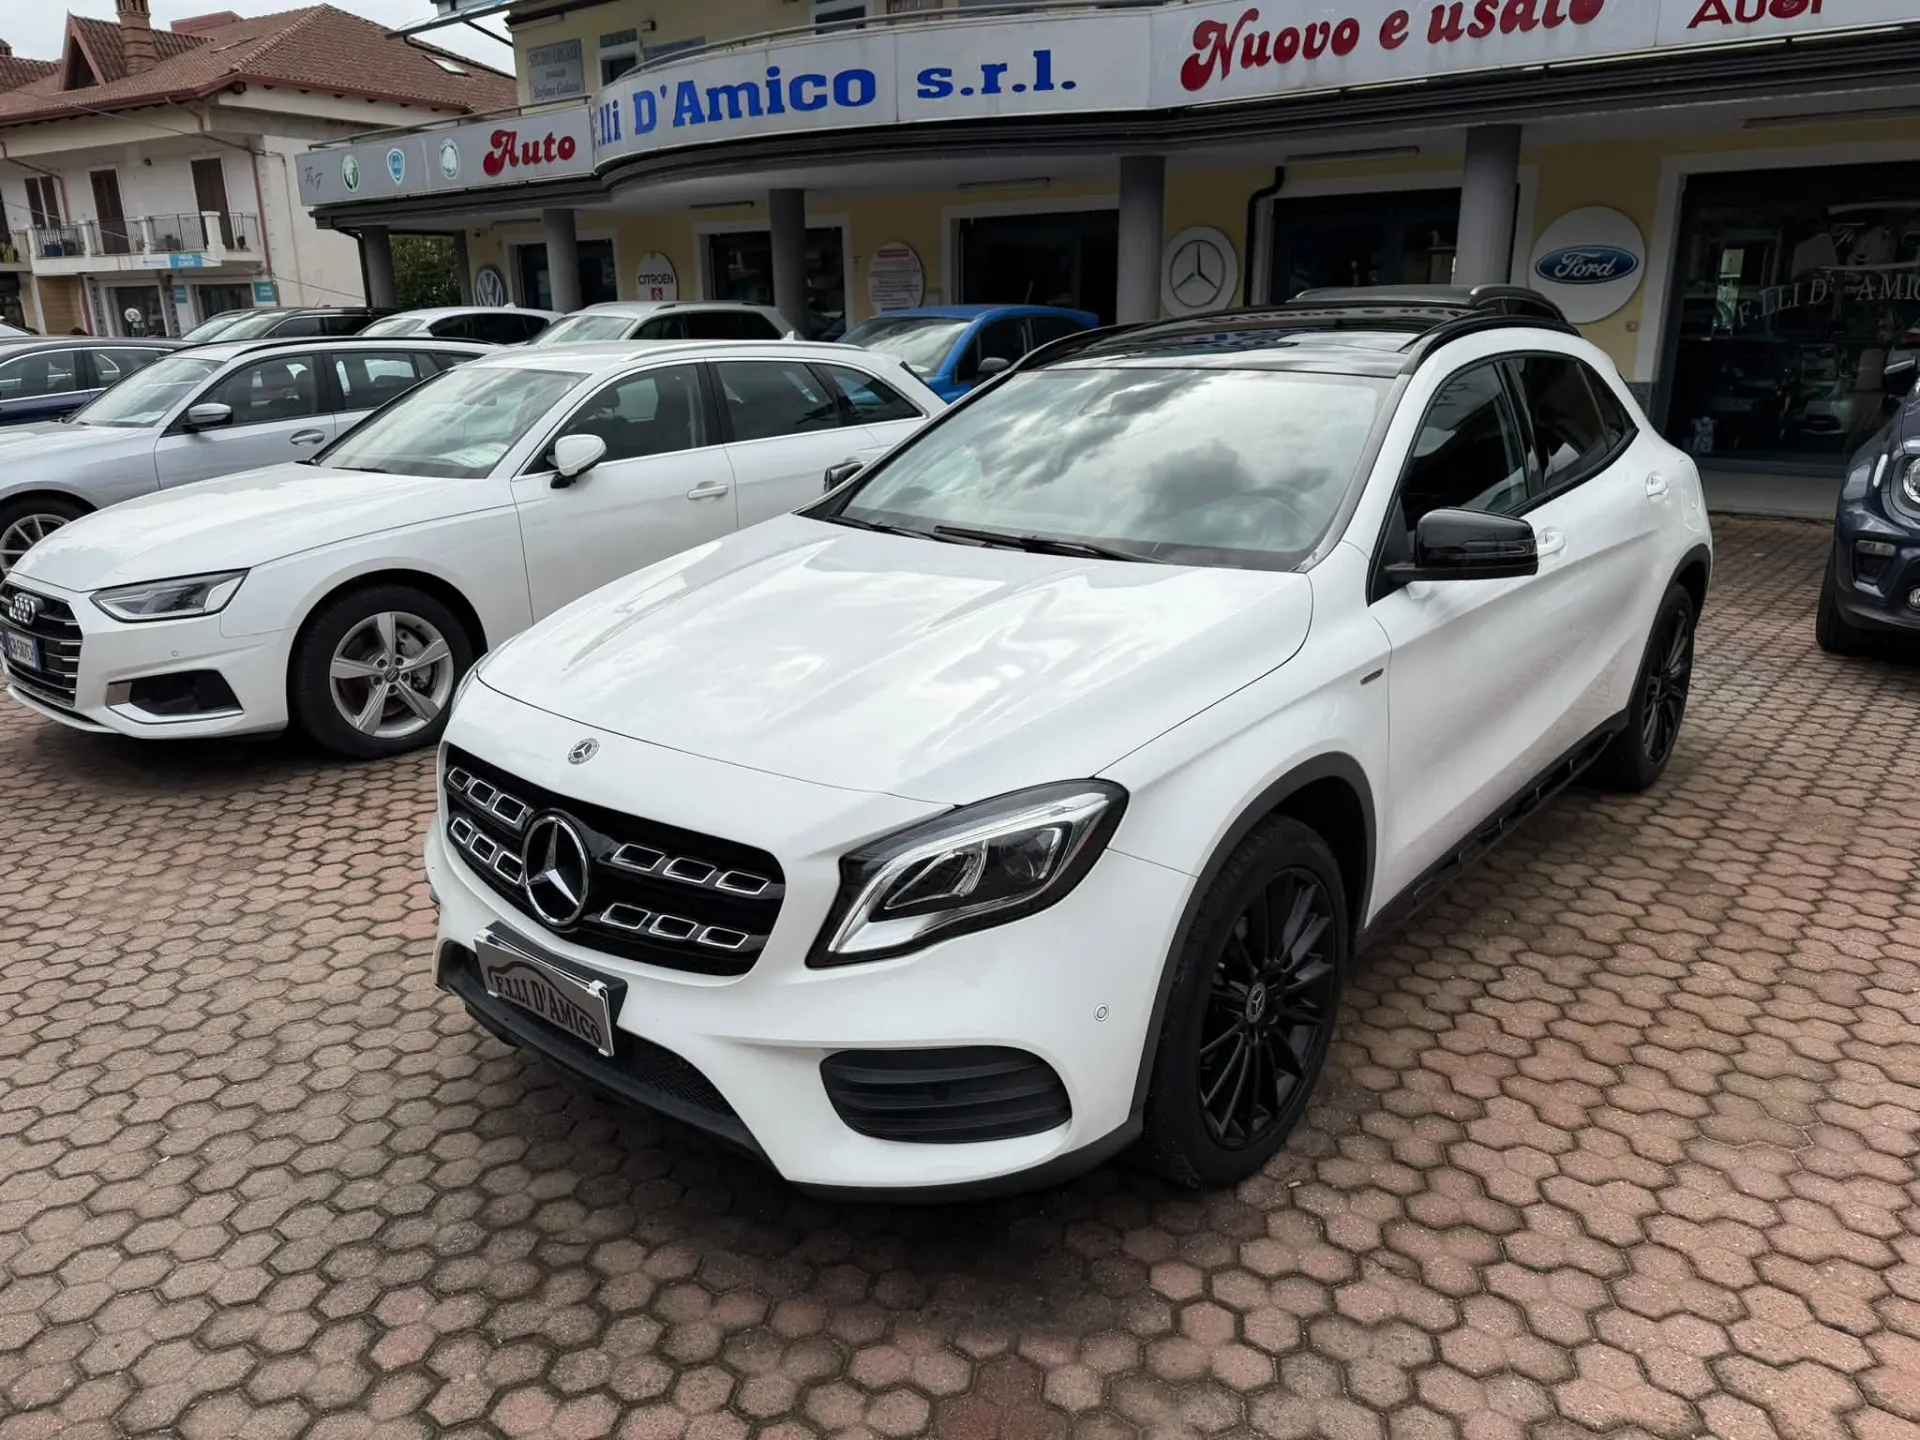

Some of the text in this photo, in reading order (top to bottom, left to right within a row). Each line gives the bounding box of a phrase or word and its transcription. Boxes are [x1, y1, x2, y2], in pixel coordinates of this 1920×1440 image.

[1181, 0, 1604, 91] Nuovo e usato
[632, 66, 876, 136] D'Amico
[917, 50, 1077, 99] s.r.l.
[483, 129, 576, 177] Auto
[1554, 252, 1618, 278] Ford
[495, 974, 602, 1046] F.LLI D'AMICO
